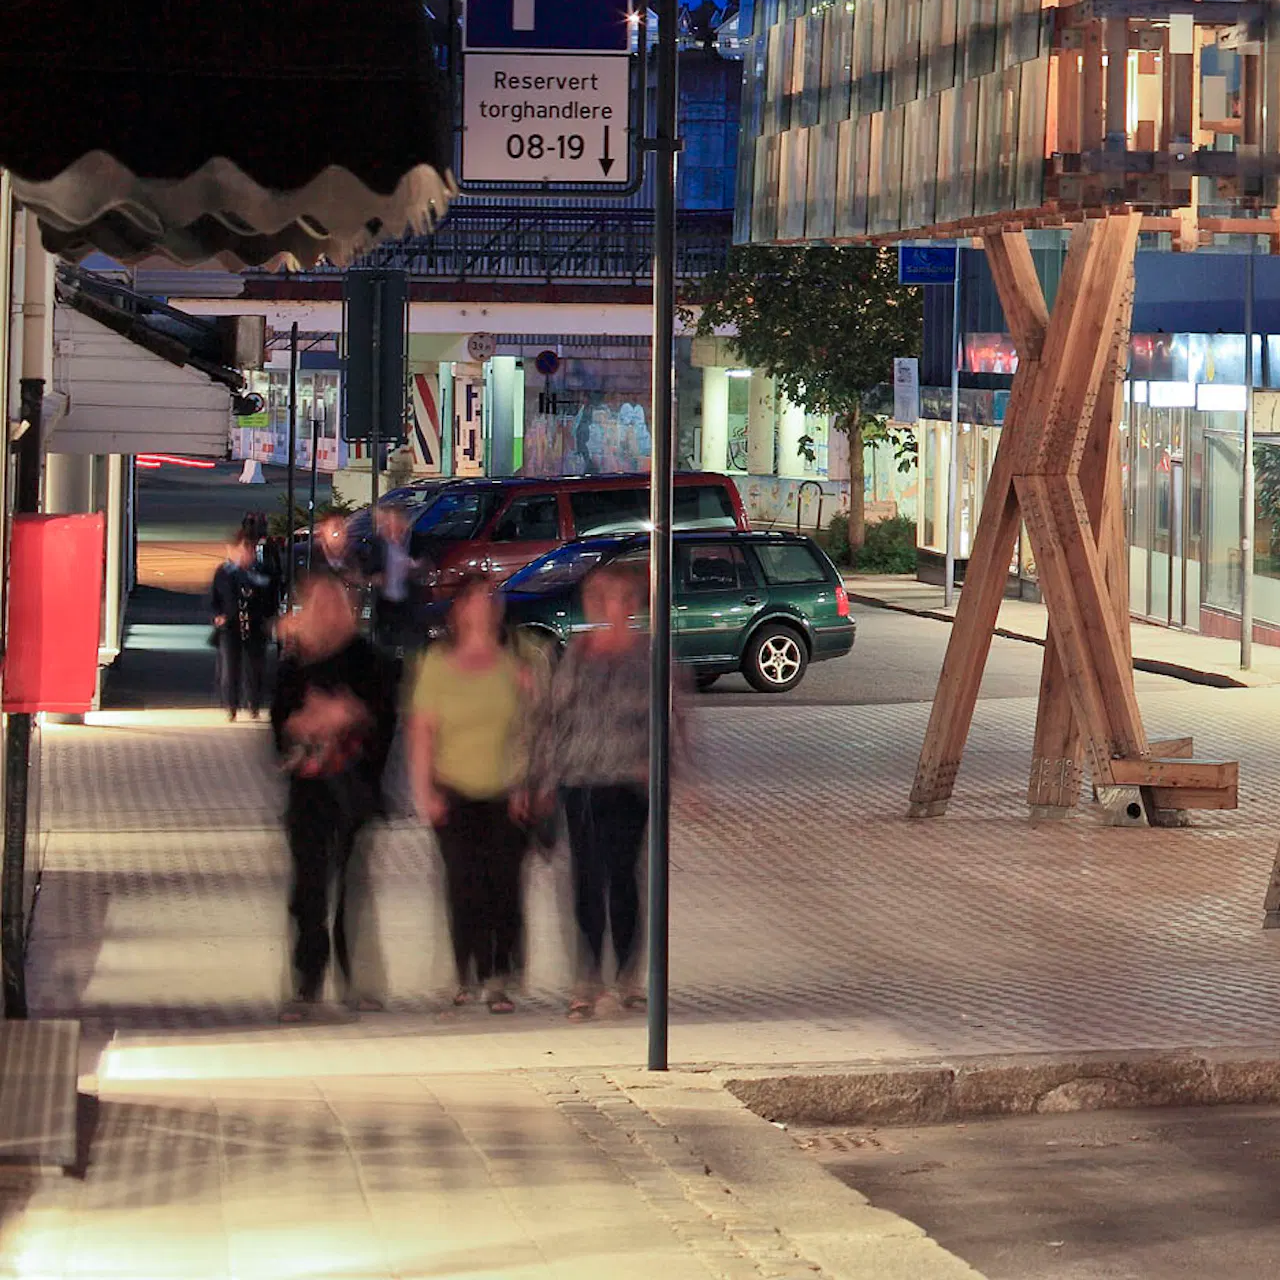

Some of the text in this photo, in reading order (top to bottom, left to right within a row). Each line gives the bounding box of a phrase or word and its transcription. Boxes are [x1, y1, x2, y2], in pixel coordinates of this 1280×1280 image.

[494, 71, 599, 90] Reservert
[479, 100, 613, 122] torghandlere
[507, 133, 585, 159] 08-19
